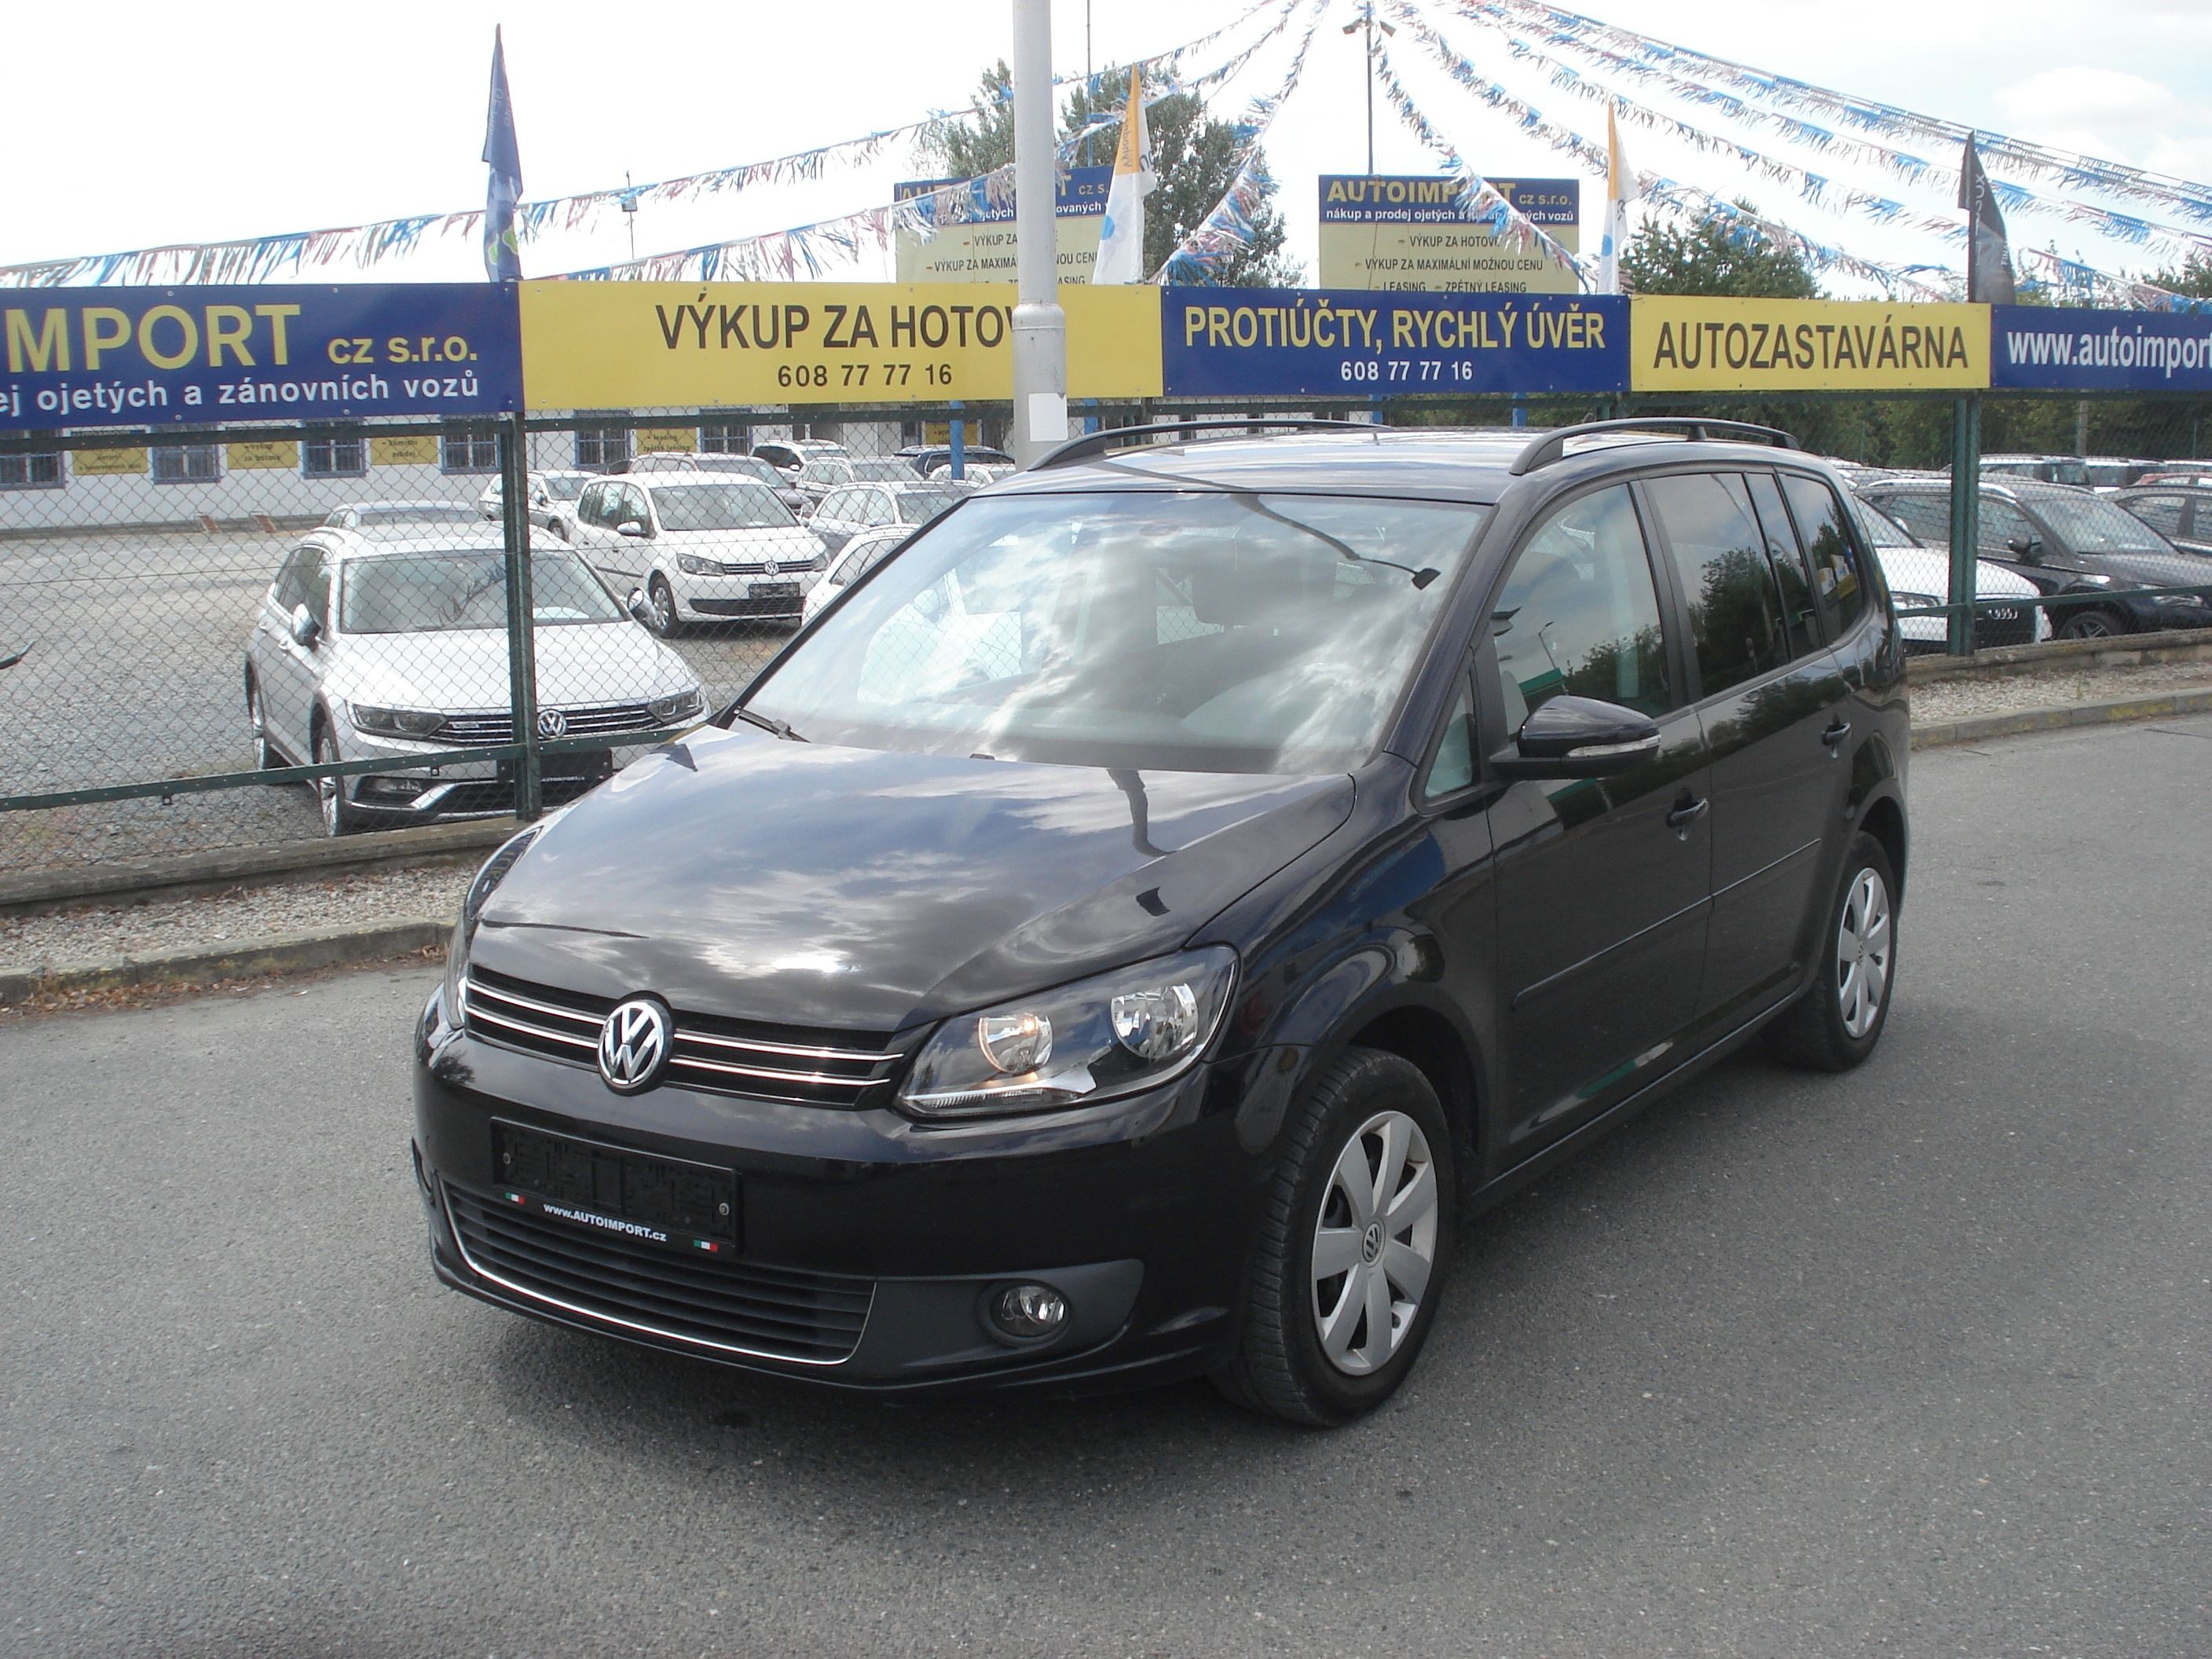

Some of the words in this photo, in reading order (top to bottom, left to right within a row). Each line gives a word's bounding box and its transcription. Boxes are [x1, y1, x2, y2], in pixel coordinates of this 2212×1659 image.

[1079, 185, 1093, 196] cz
[1327, 181, 1516, 203] AUTOIMPT
[1518, 194, 1535, 204] cz
[1538, 193, 1572, 205] s.r.o.
[1326, 207, 1361, 221] nákup
[1364, 211, 1372, 219] a
[1375, 209, 1412, 222] prodej
[1415, 209, 1455, 222] ojetých
[1547, 210, 1573, 222] vozů
[974, 233, 1003, 247] VÝKUP
[1006, 233, 1018, 245] ZA
[1409, 233, 1443, 247] VÝKUP
[1445, 236, 1459, 247] ZA
[934, 258, 965, 273] VÝKUP
[967, 258, 979, 270] ZA
[981, 254, 1018, 269] MAXIMÁ
[1365, 255, 1398, 270] VÝKUP
[1401, 258, 1414, 270] ZA
[1417, 256, 1470, 270] MAXIMÁLNÍ
[1473, 256, 1514, 270] MOŽNOU
[1517, 258, 1544, 270] CENU
[1383, 281, 1426, 292] LEASING
[1445, 279, 1483, 292] ZPĚTNÝ
[1485, 281, 1527, 292] LEASING
[655, 294, 810, 350] VÝKUP
[823, 305, 879, 348] ZA
[1185, 298, 1382, 354] PROTIÚČTY,
[1393, 302, 1518, 349] RYCHLÝ
[1526, 303, 1606, 349] ÚVĚR
[328, 338, 372, 364] cz
[388, 335, 478, 364] s.r.o.
[1654, 314, 1969, 369] AUTOZASTAVÁRNA
[778, 365, 828, 387] 608
[841, 364, 870, 387] 77
[883, 364, 911, 386] 77
[925, 363, 952, 386] 16
[1341, 361, 1379, 382] 608
[1388, 361, 1411, 382] 77
[1419, 361, 1442, 381] 77
[1452, 361, 1473, 381] 16
[37, 380, 167, 415] ojetých
[185, 388, 202, 405] a
[219, 373, 388, 404] zánovních
[404, 369, 478, 397] vozů
[544, 1203, 667, 1241] www.AUTOIMPORT.cz
